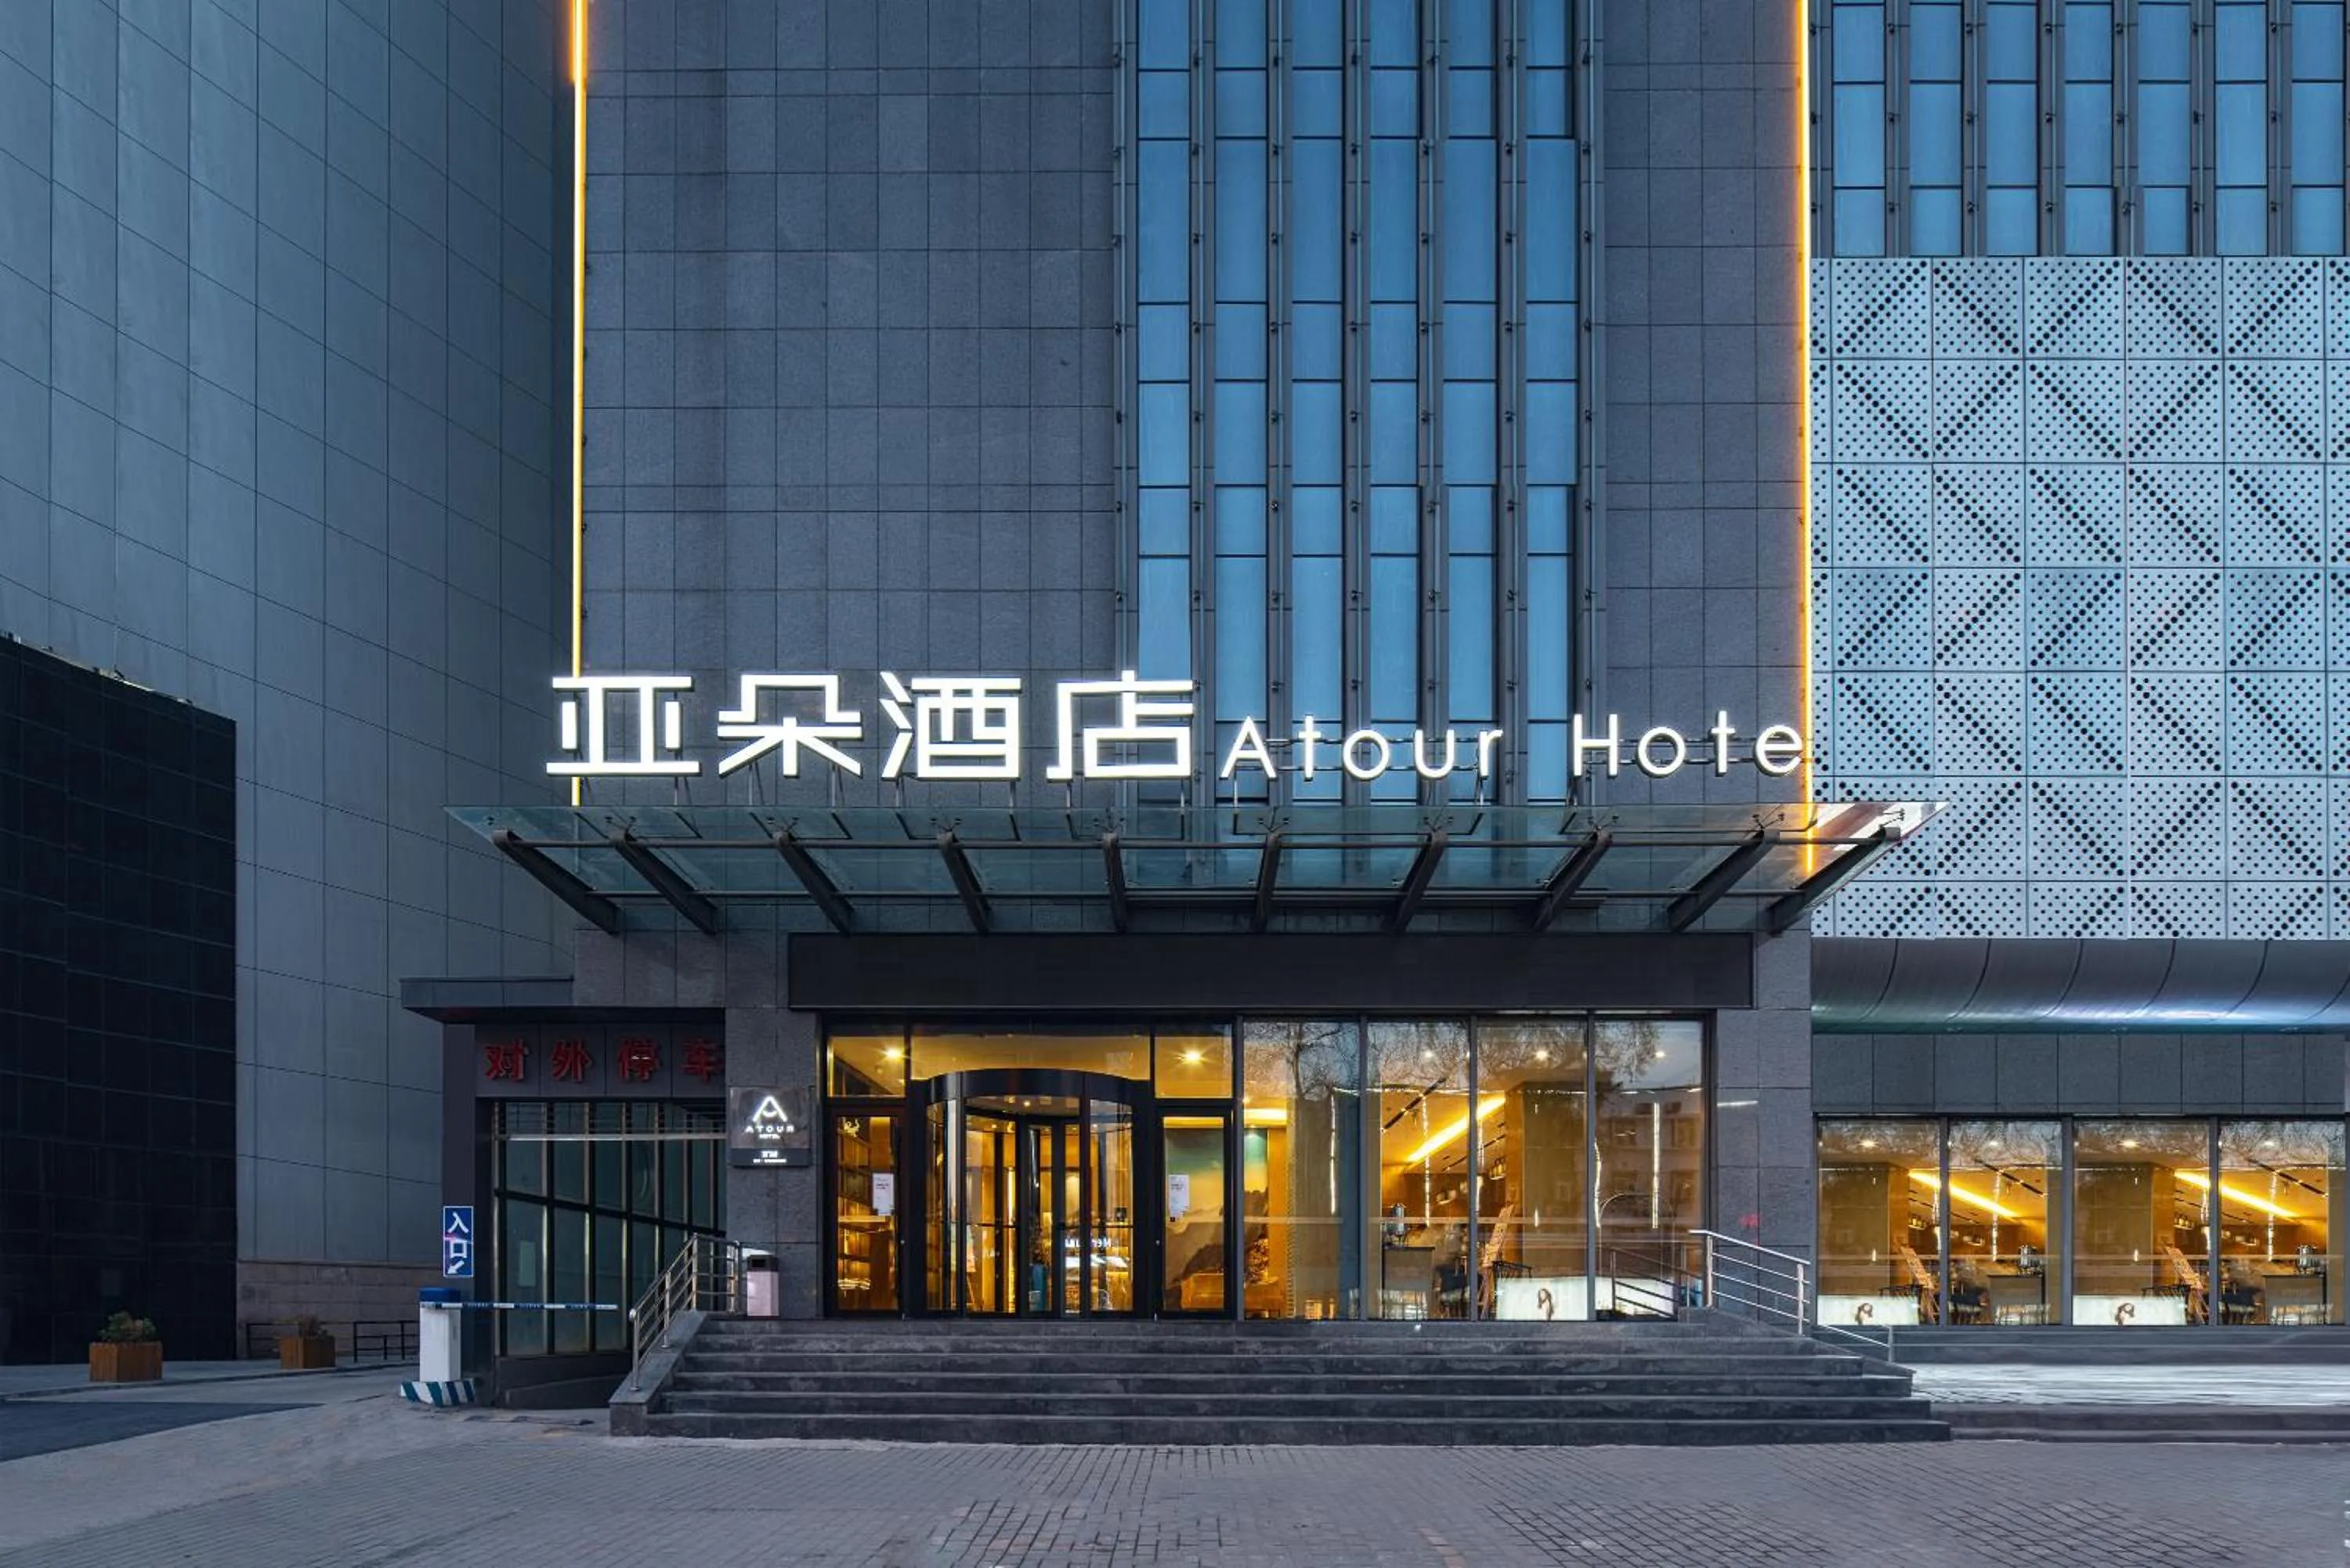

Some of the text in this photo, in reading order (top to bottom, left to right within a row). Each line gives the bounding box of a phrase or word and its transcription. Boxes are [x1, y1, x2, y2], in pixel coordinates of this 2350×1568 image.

[546, 670, 1195, 780] 亚朵酒店
[1220, 714, 1504, 780] Atour
[485, 1039, 724, 1082] 对外停车
[745, 1125, 794, 1133] ATOUR
[447, 1212, 469, 1259] 入口
